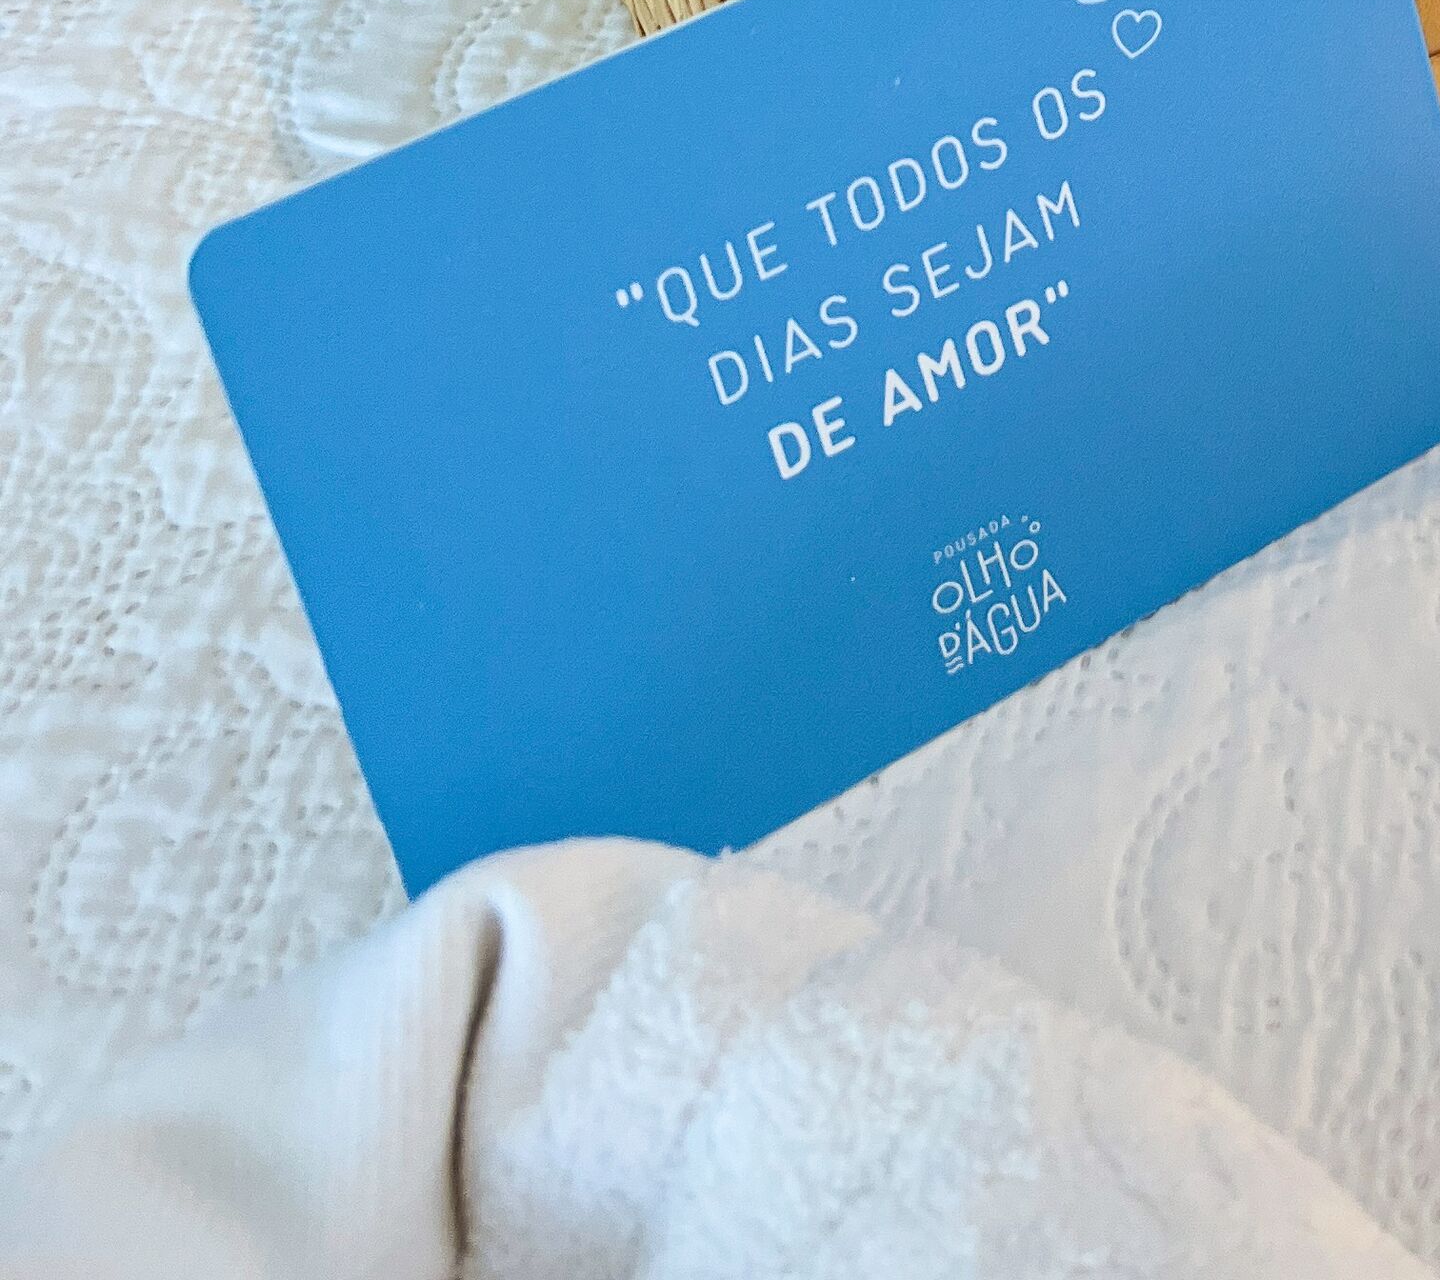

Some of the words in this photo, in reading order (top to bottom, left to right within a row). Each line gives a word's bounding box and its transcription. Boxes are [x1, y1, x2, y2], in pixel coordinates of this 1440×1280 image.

[615, 220, 789, 327] "QUE
[805, 116, 1008, 247] TODOS
[1031, 68, 1107, 140] OS
[707, 295, 860, 407] DIAS
[882, 180, 1081, 318] SEJAM
[767, 395, 857, 481] DE
[882, 278, 1071, 428] AMOR"
[931, 538, 1040, 615] OLHO
[932, 514, 1011, 566] POUSADA
